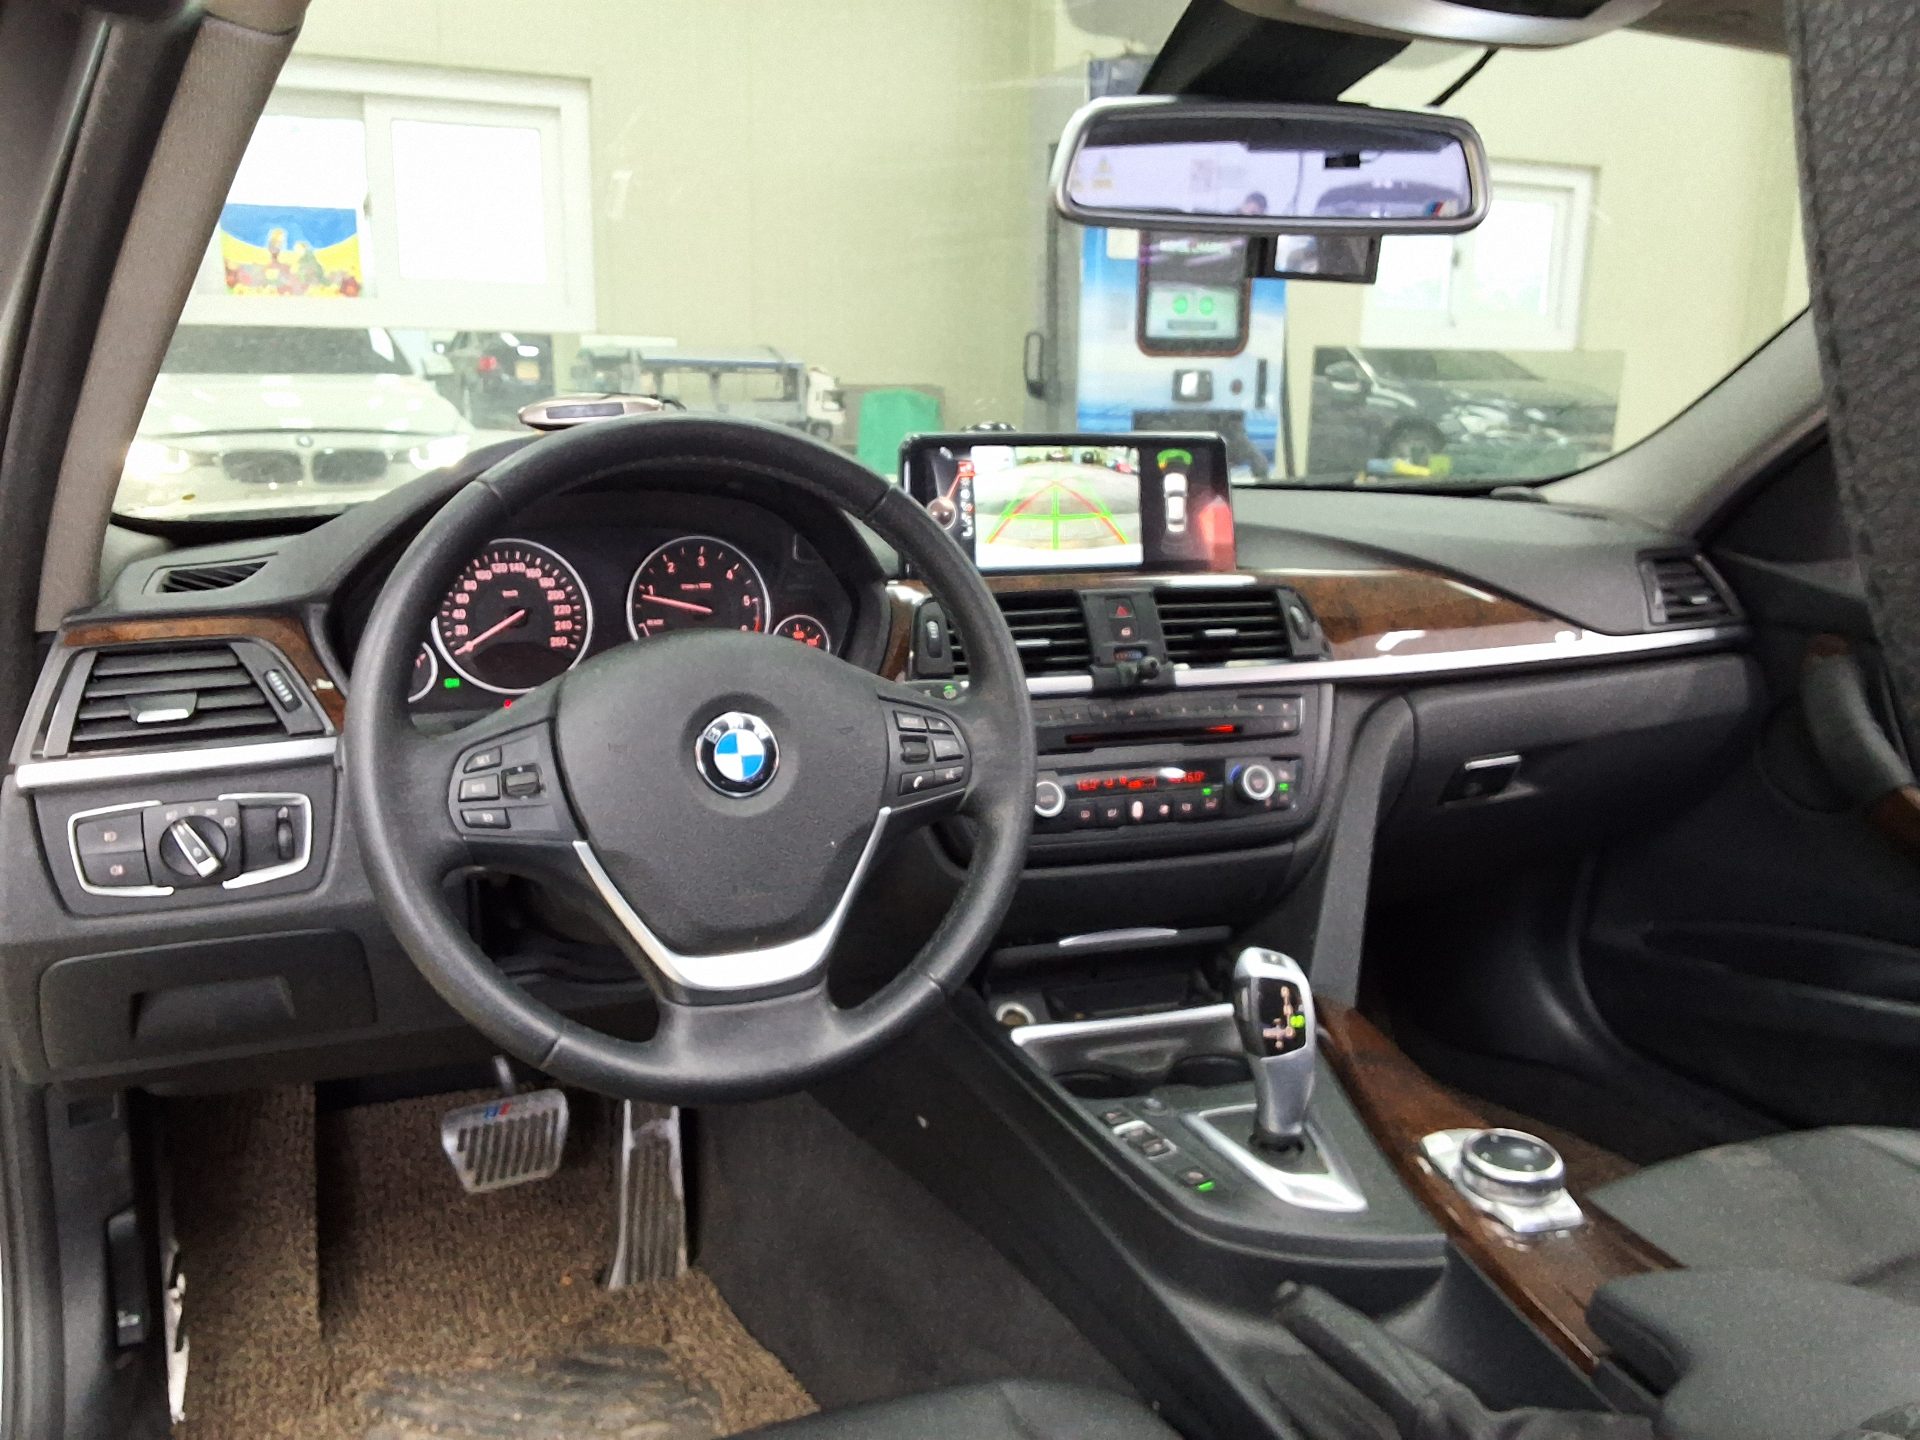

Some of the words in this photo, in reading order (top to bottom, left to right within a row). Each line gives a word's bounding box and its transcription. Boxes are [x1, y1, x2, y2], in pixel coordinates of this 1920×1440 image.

[697, 556, 705, 567] 3
[667, 562, 675, 573] 2
[726, 569, 733, 580] 4
[648, 584, 654, 595] 1
[554, 604, 571, 615] 220
